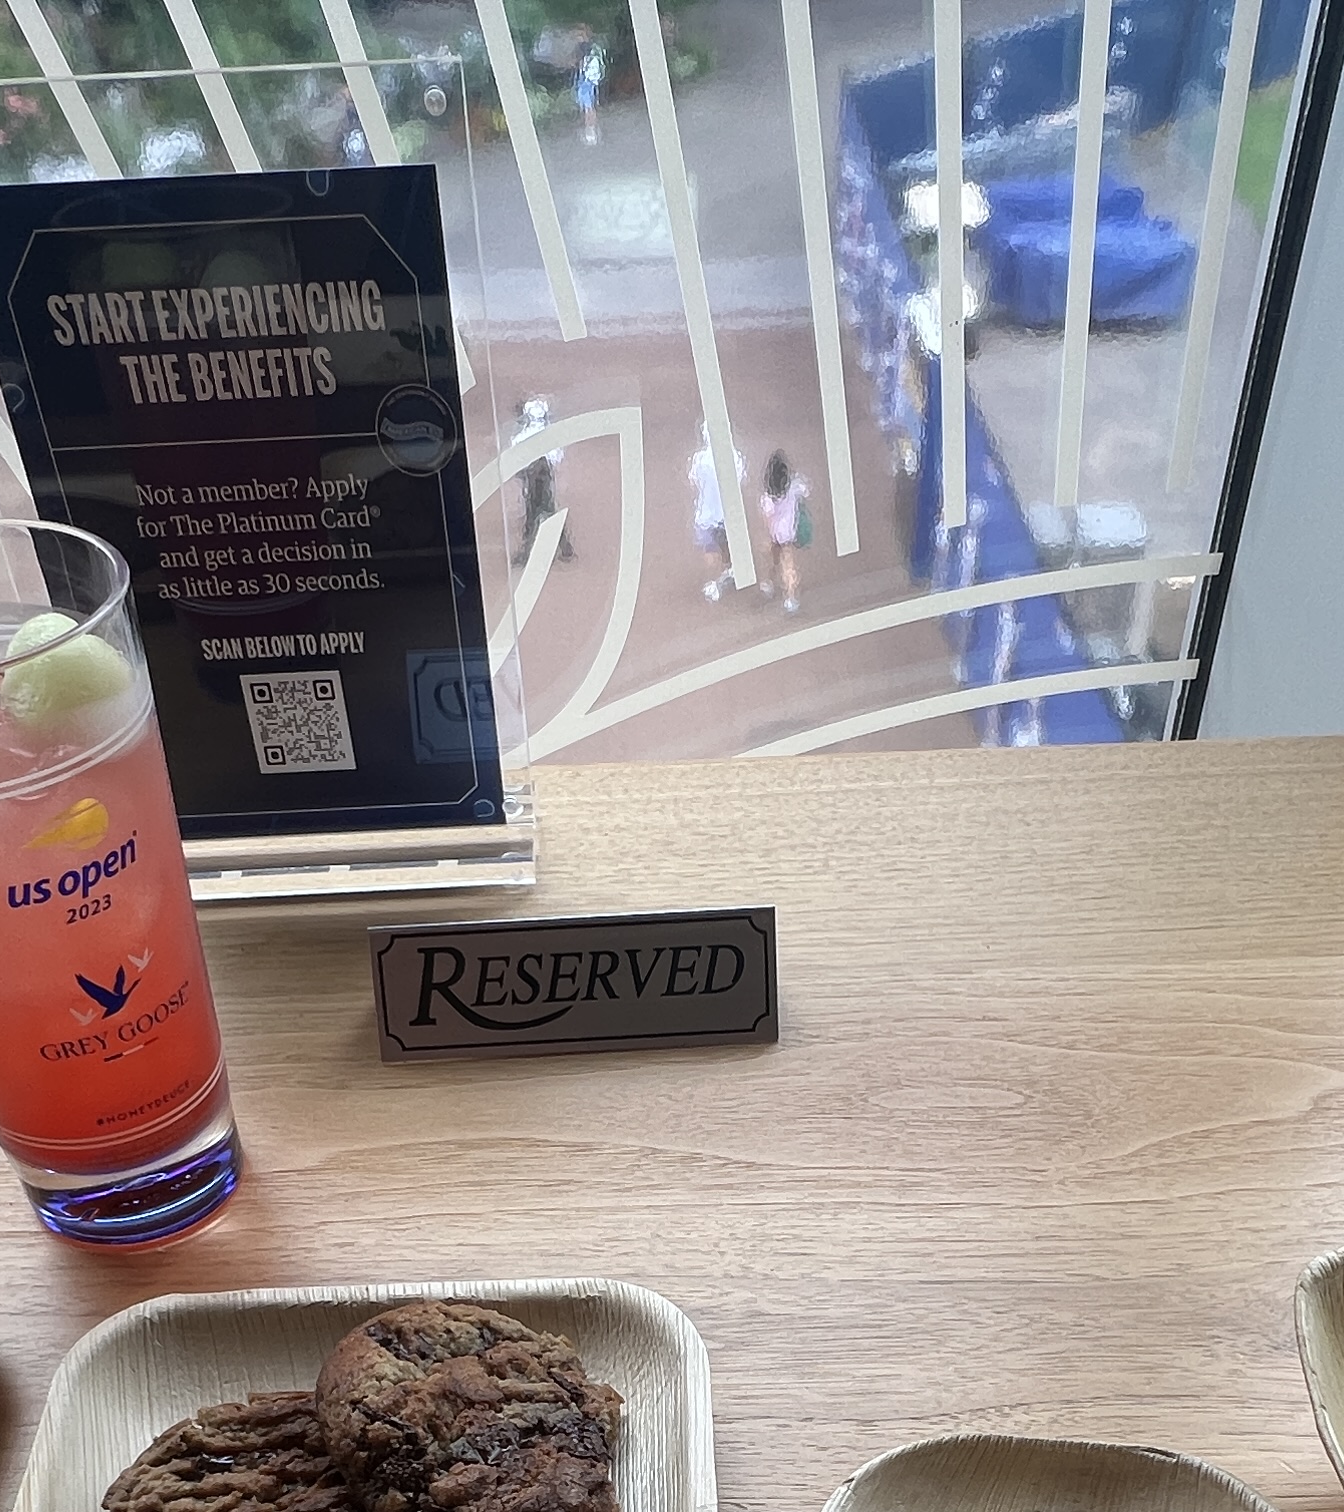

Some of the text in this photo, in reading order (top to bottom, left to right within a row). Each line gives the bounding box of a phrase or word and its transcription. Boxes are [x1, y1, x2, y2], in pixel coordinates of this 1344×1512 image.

[46, 279, 386, 347] START EXPERIENCING
[119, 346, 337, 404] THE BENEFITS
[135, 473, 368, 507] Not a member? Apply
[136, 516, 166, 538] for
[170, 513, 213, 537] The
[217, 511, 317, 535] Platinum
[160, 538, 372, 572] and get a decision in
[158, 568, 385, 599] as little as 30 seconds.
[201, 631, 365, 661] SCAN BELOW TO APPLY
[8, 838, 136, 908] us open
[66, 893, 111, 925] 2023
[409, 943, 746, 1030] RESERVED
[39, 987, 189, 1061] GREY GOOSE
